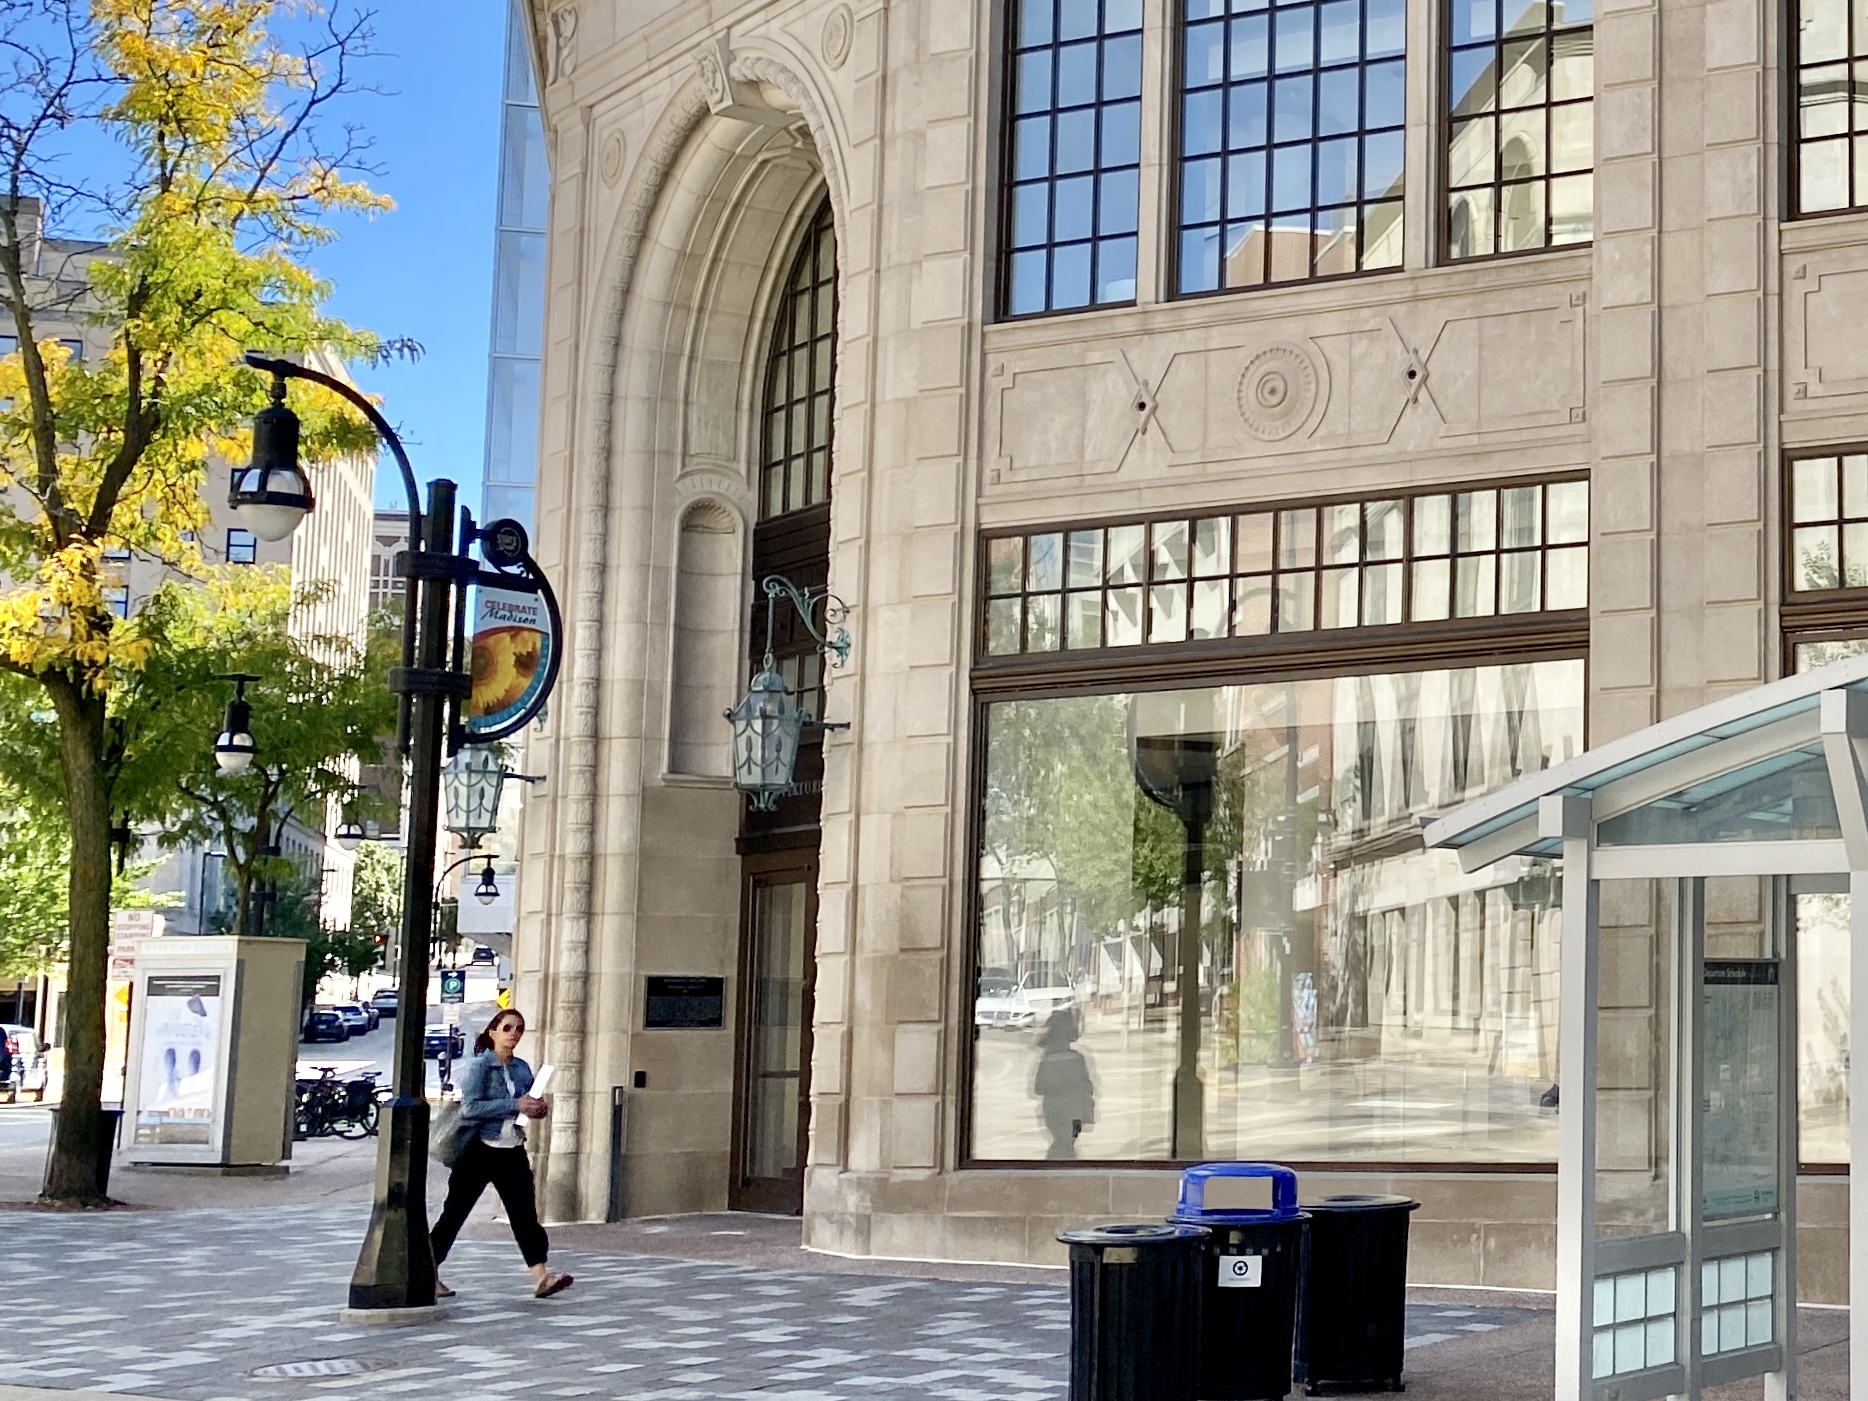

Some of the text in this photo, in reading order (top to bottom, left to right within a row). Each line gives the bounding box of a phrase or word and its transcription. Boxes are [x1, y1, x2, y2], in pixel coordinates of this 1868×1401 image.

[480, 607, 537, 625] Madison
[485, 600, 538, 616] CELEBRATE
[128, 913, 141, 921] NO
